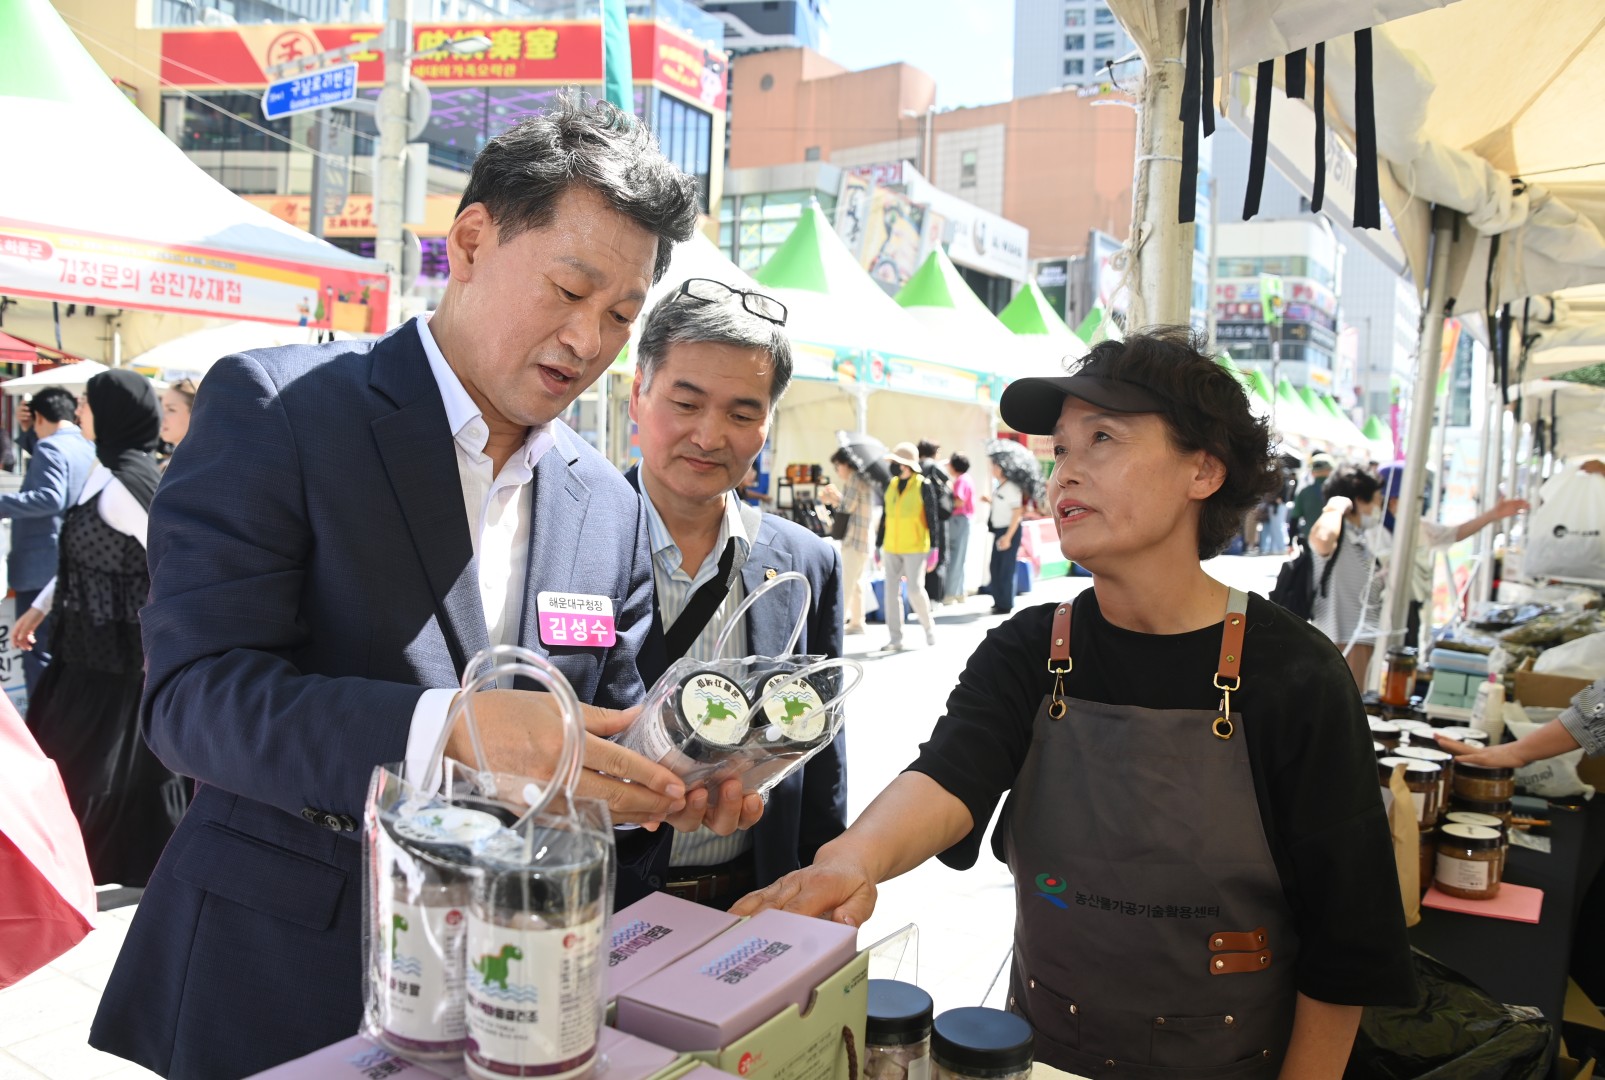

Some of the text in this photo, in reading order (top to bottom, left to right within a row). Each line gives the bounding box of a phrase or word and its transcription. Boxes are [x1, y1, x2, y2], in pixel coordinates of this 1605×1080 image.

[58, 257, 141, 292] 김정문의
[149, 268, 242, 305] 섬진강재첩
[548, 597, 603, 612] 해운대구청장
[549, 617, 608, 643] 김성수
[1074, 891, 1220, 919] 농산물가공기술활용센터
